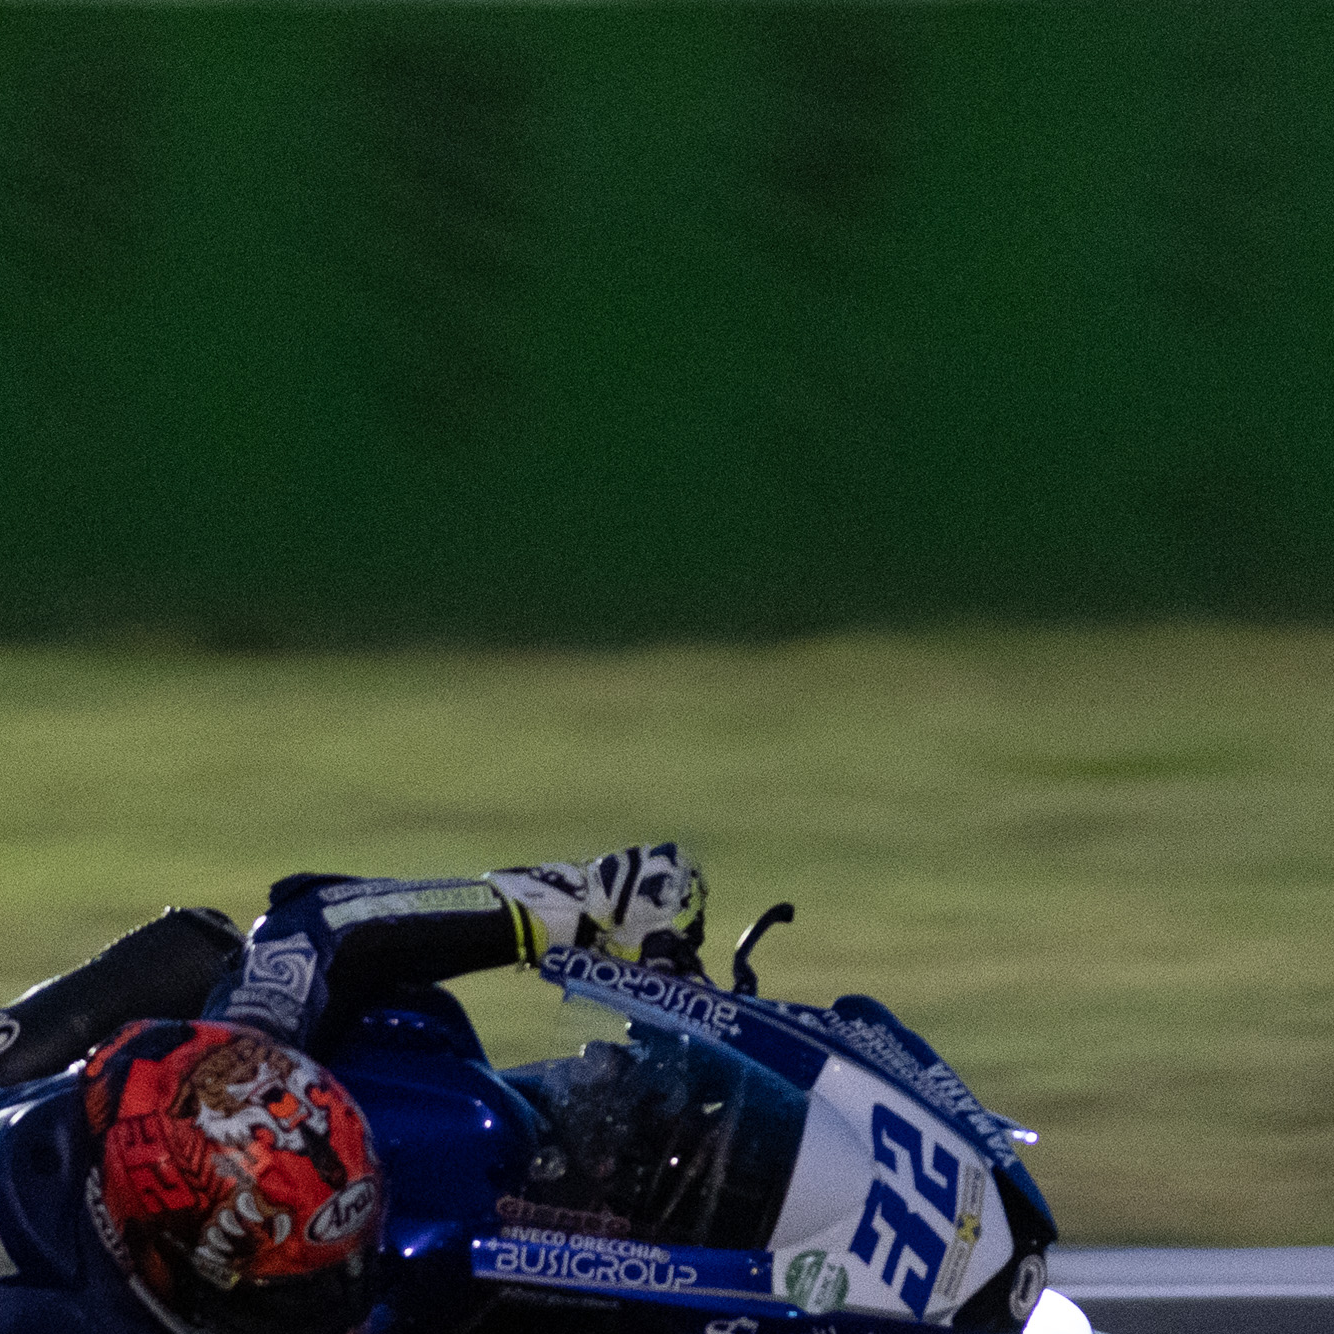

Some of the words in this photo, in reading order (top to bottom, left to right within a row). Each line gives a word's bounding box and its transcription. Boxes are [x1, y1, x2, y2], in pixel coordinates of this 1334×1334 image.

[542, 946, 739, 1028] BUSIGROUP
[849, 1103, 960, 1320] 32
[495, 1244, 698, 1291] BUSIGROUP
[512, 1227, 567, 1247] IVECO
[569, 1234, 662, 1263] ORECCHIA
